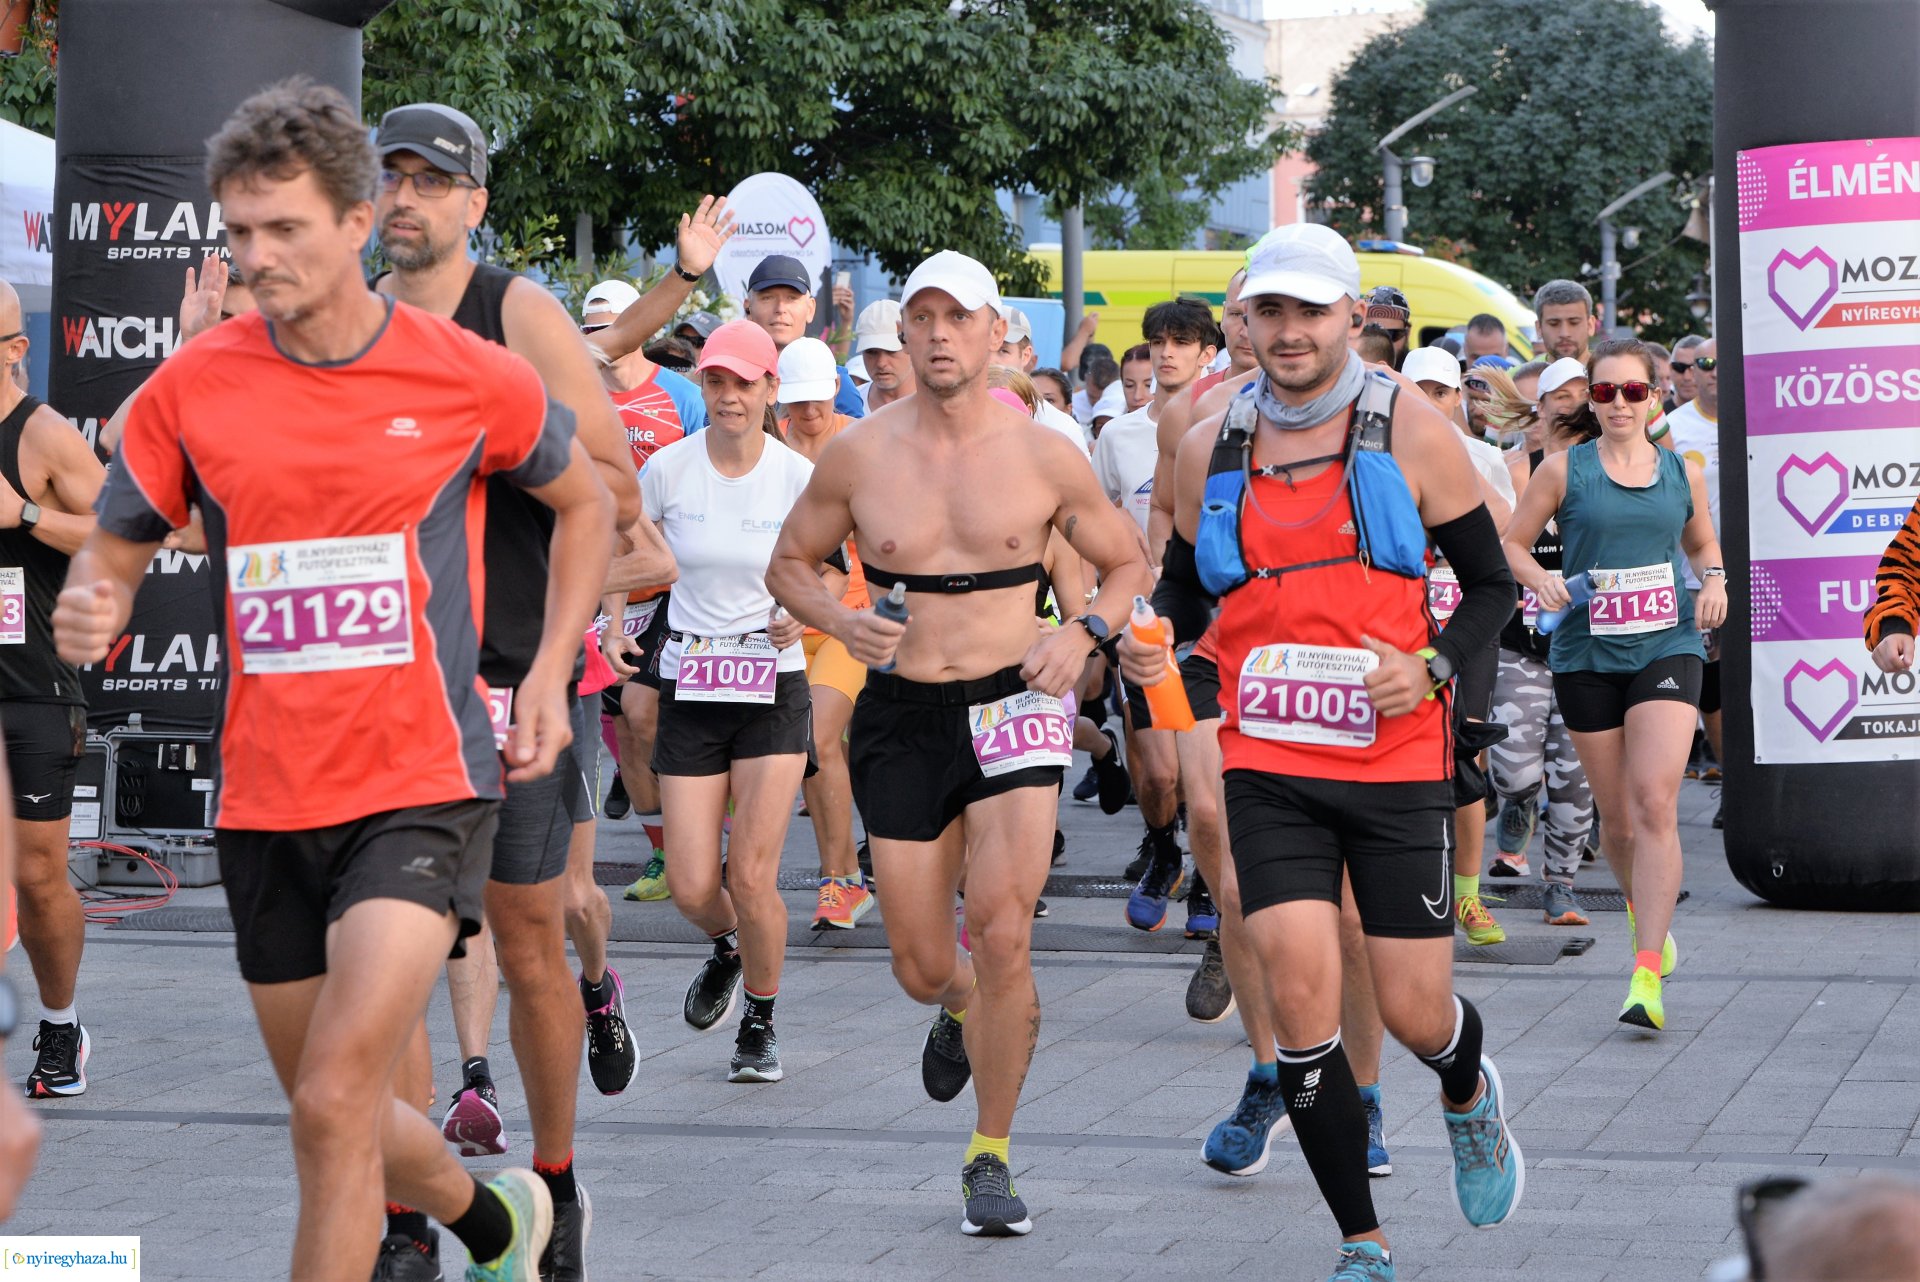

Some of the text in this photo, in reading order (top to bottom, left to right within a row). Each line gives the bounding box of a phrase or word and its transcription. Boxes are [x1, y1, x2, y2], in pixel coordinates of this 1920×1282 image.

[1788, 153, 1920, 201] ÉLMÉN
[107, 247, 191, 259] SPORTS
[1775, 363, 1920, 408] KÖZÖSS
[1852, 513, 1905, 528] DEBR
[1592, 590, 1675, 619] 21143
[1819, 579, 1876, 614] FU
[2, 598, 20, 625] 3
[239, 586, 403, 642] 21129
[102, 678, 220, 691] SPORTS TI
[682, 659, 774, 685] 21007
[1861, 669, 1920, 696] MO
[1244, 681, 1371, 725] 21005
[1861, 719, 1920, 734] TOKAJ
